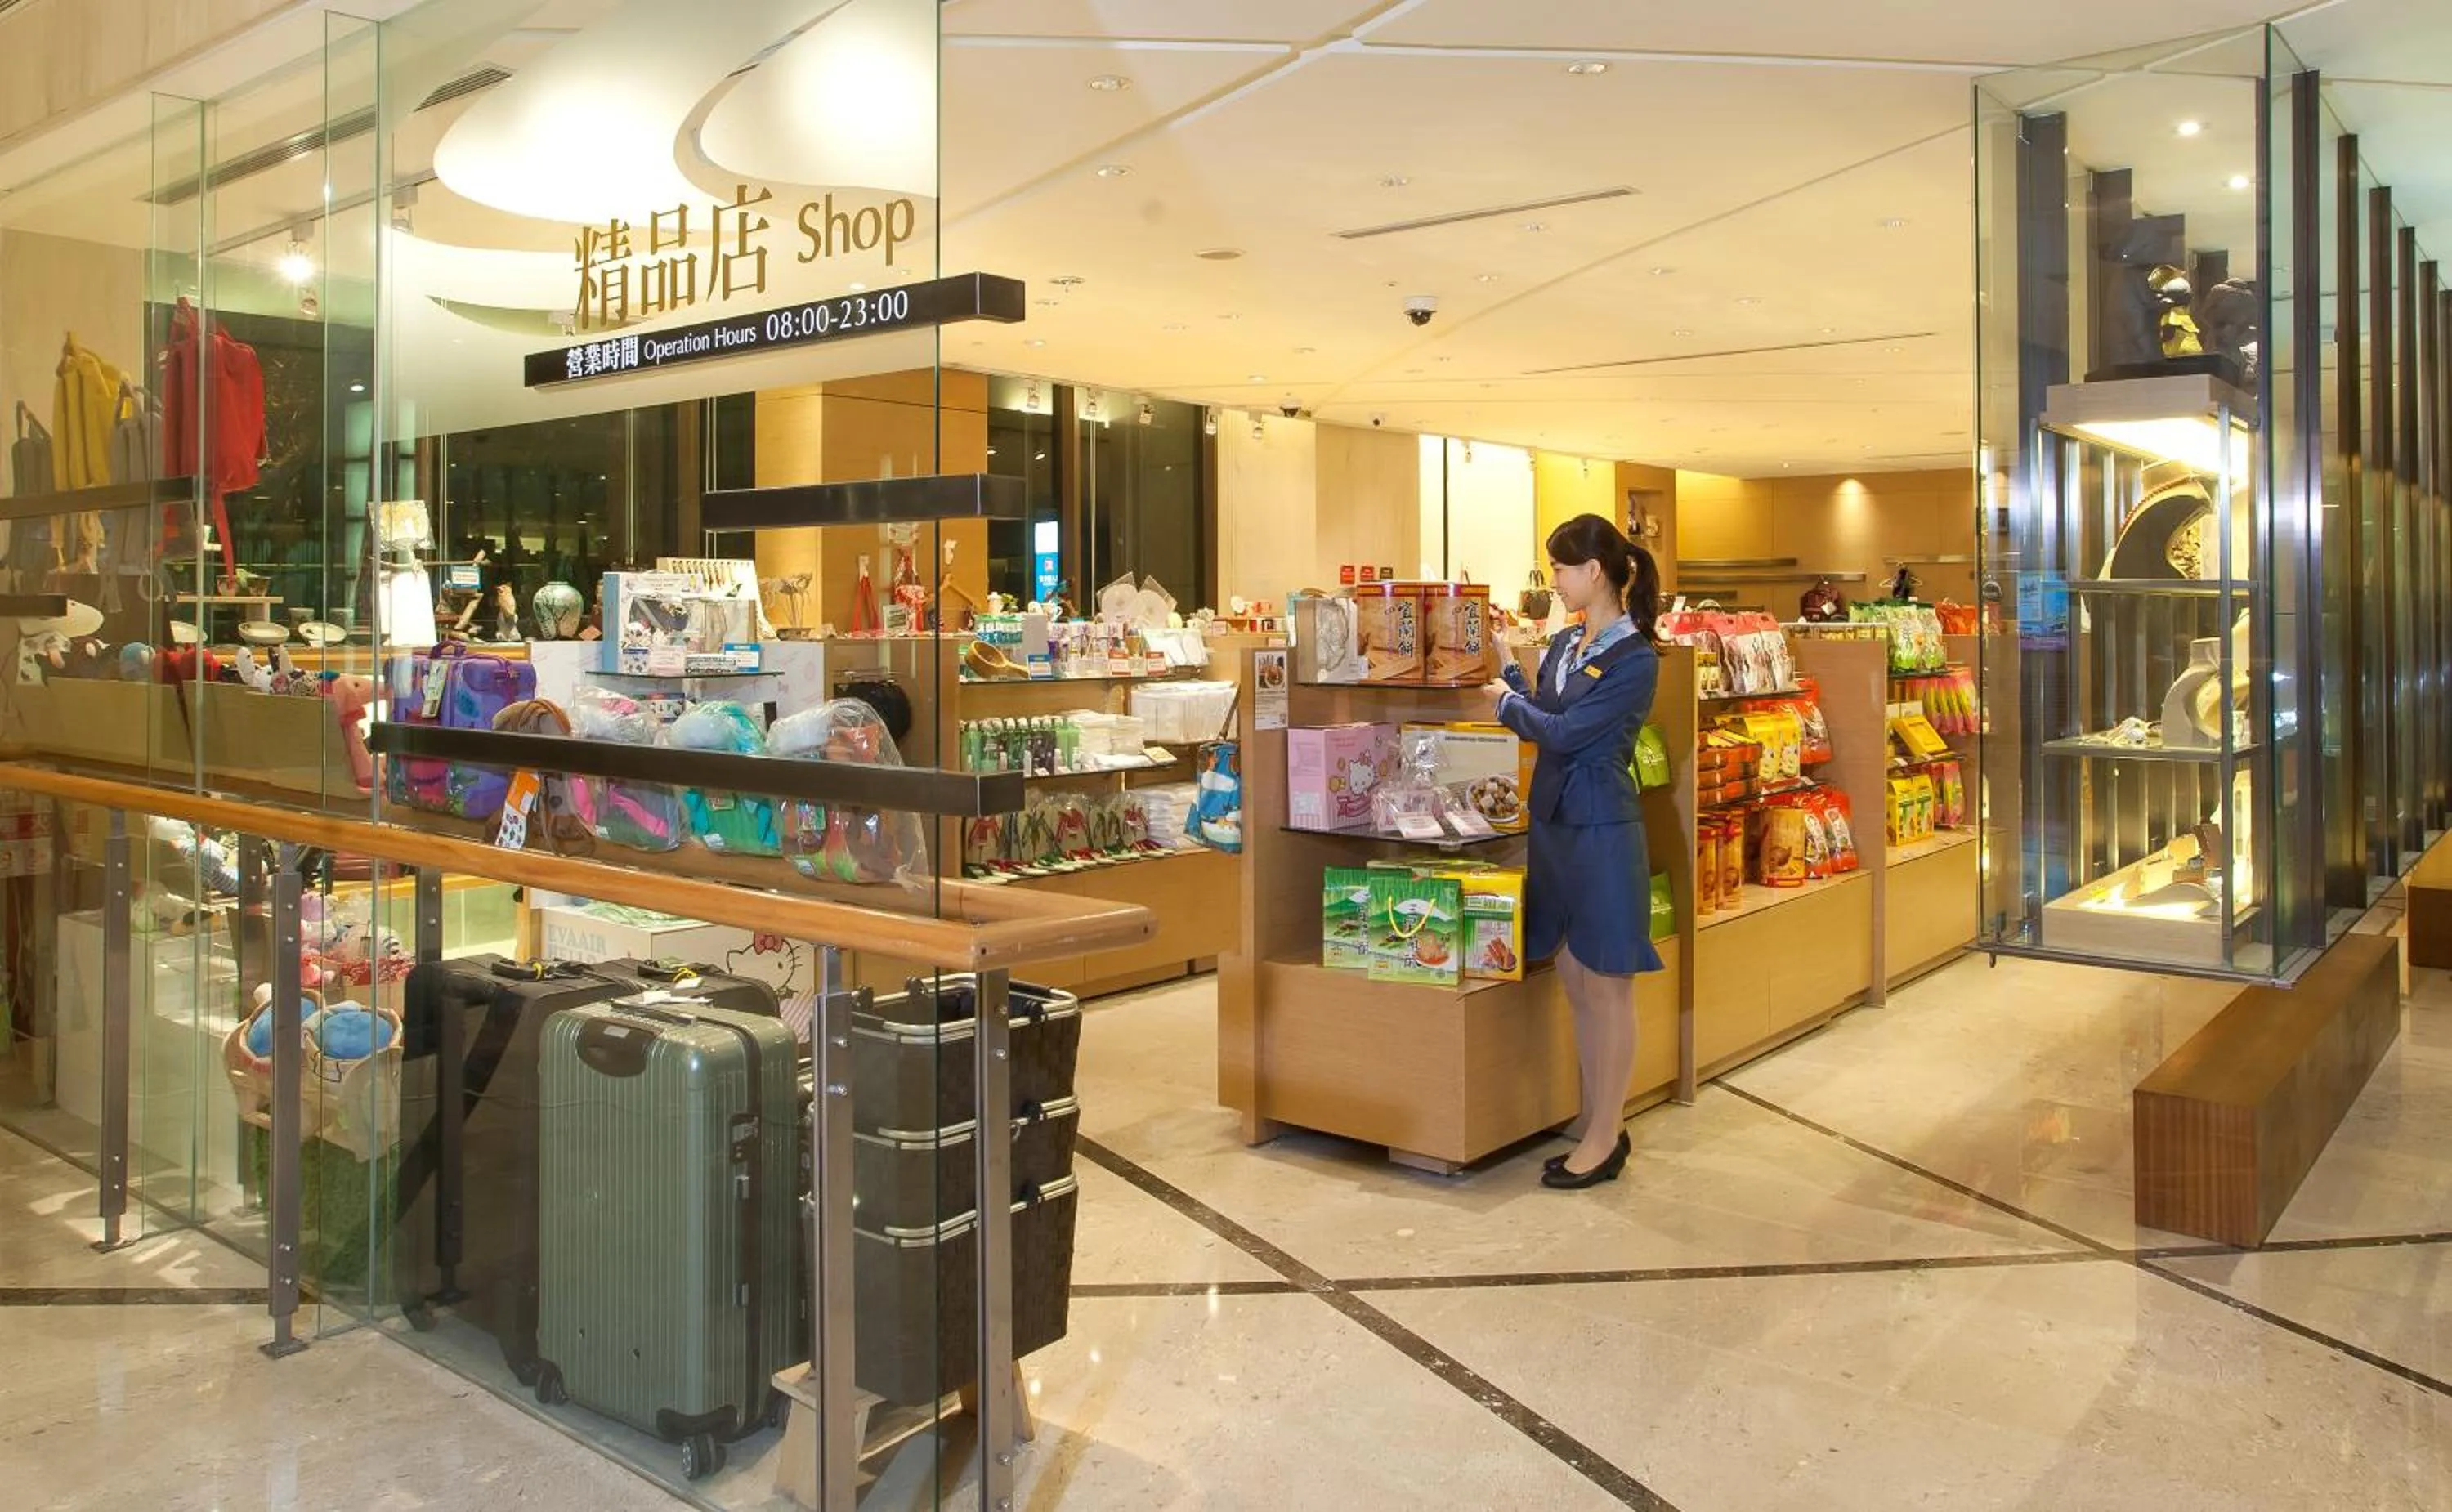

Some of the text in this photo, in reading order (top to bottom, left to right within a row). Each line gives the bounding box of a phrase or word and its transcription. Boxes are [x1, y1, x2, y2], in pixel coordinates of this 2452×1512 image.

[574, 184, 915, 330] 精品店 Shop
[566, 290, 909, 379] 營業時間 Operation Hours 08:00-23:00
